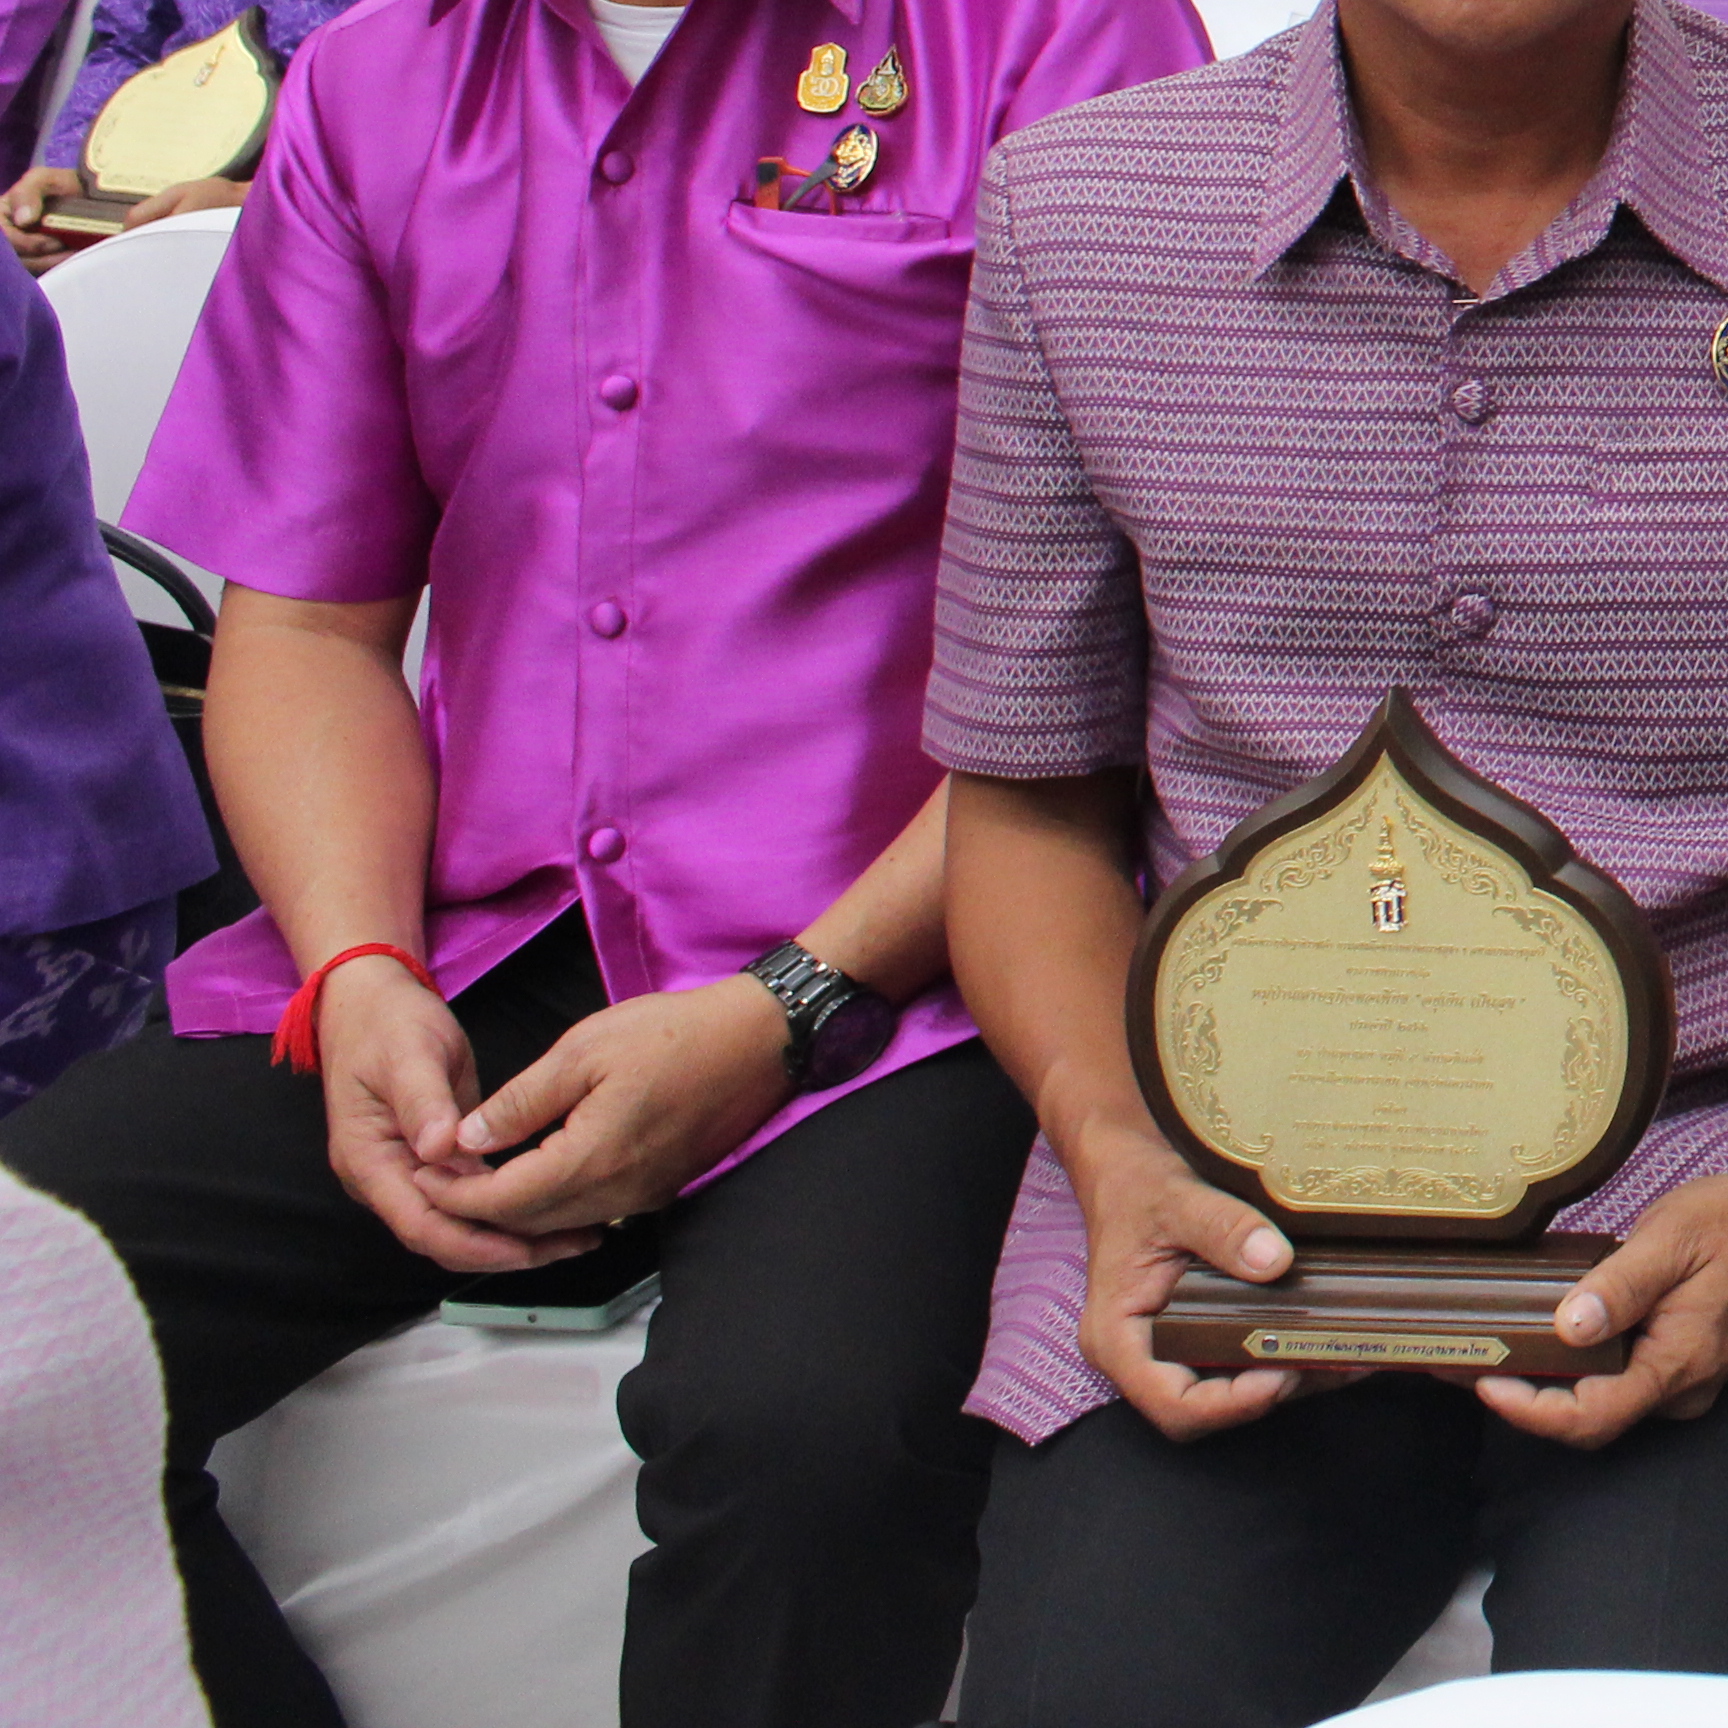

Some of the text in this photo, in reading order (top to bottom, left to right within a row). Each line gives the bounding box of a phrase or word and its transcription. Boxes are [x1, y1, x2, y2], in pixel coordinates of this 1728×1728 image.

[1285, 1338, 1489, 1357] กรมการพัฒนาชุมชน กระทรวงมหาดไทย
